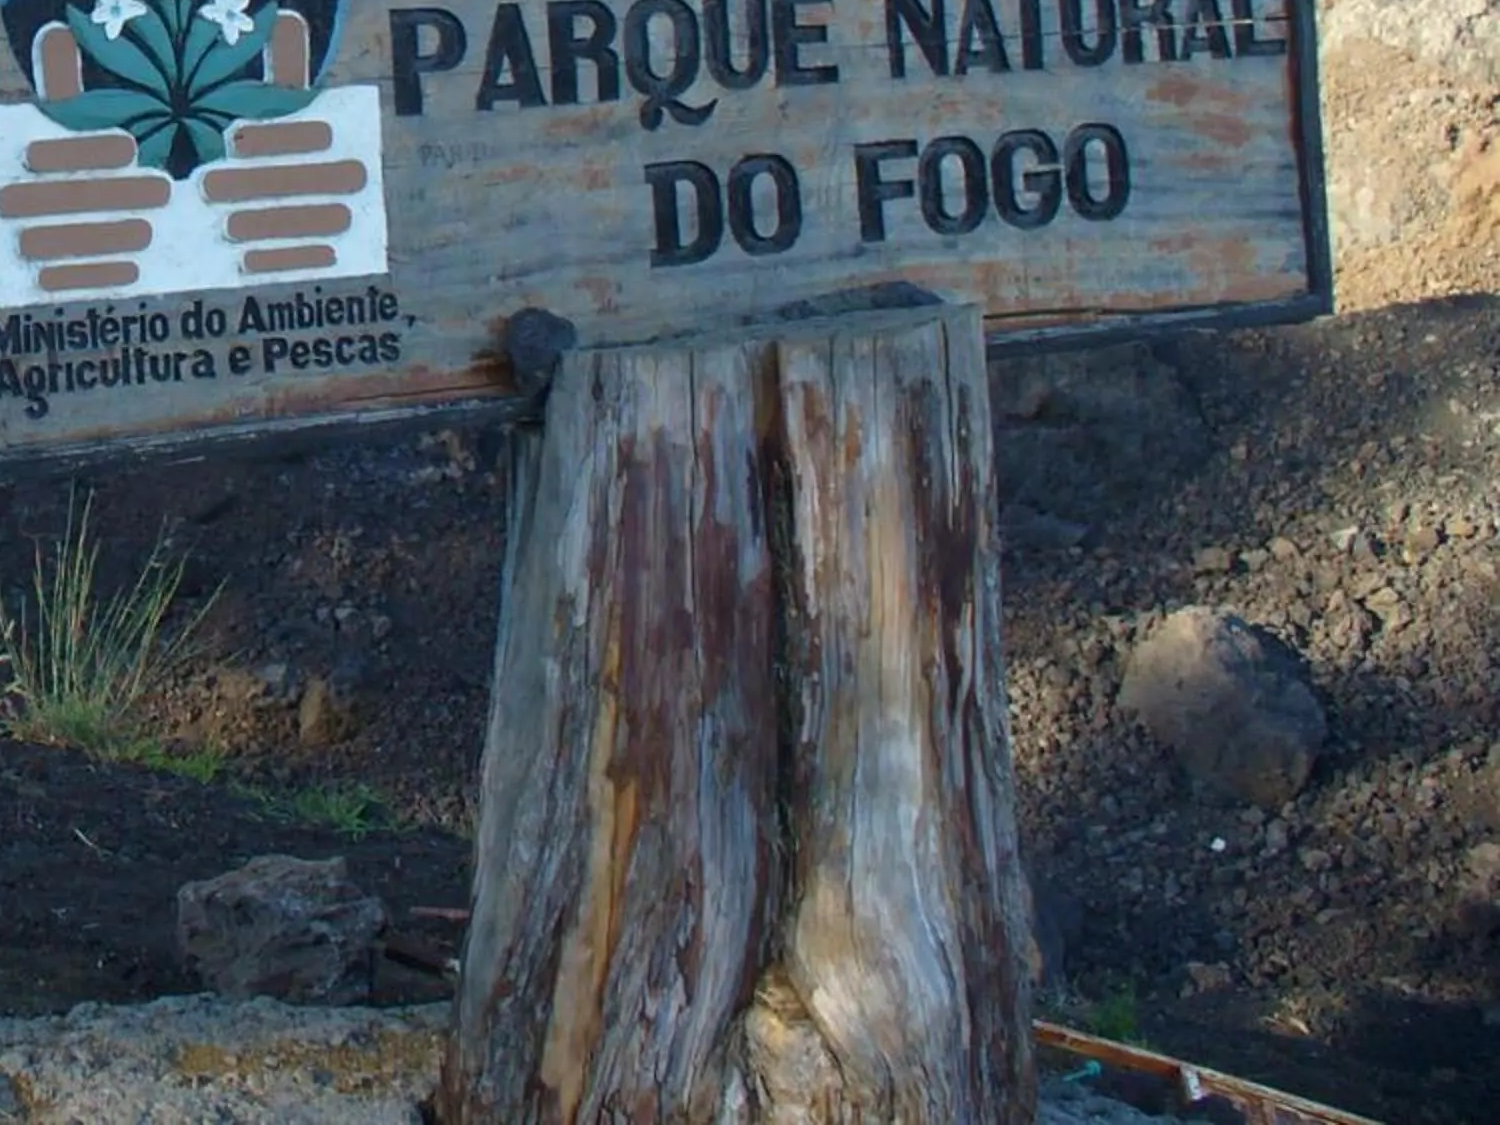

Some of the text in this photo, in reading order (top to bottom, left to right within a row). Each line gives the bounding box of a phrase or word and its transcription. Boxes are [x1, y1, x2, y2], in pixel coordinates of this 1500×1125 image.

[644, 122, 1132, 268] DO FOGO
[180, 299, 228, 339] do
[237, 285, 417, 334] Ambiente,
[228, 344, 252, 375] e
[262, 332, 402, 374] Pescas
